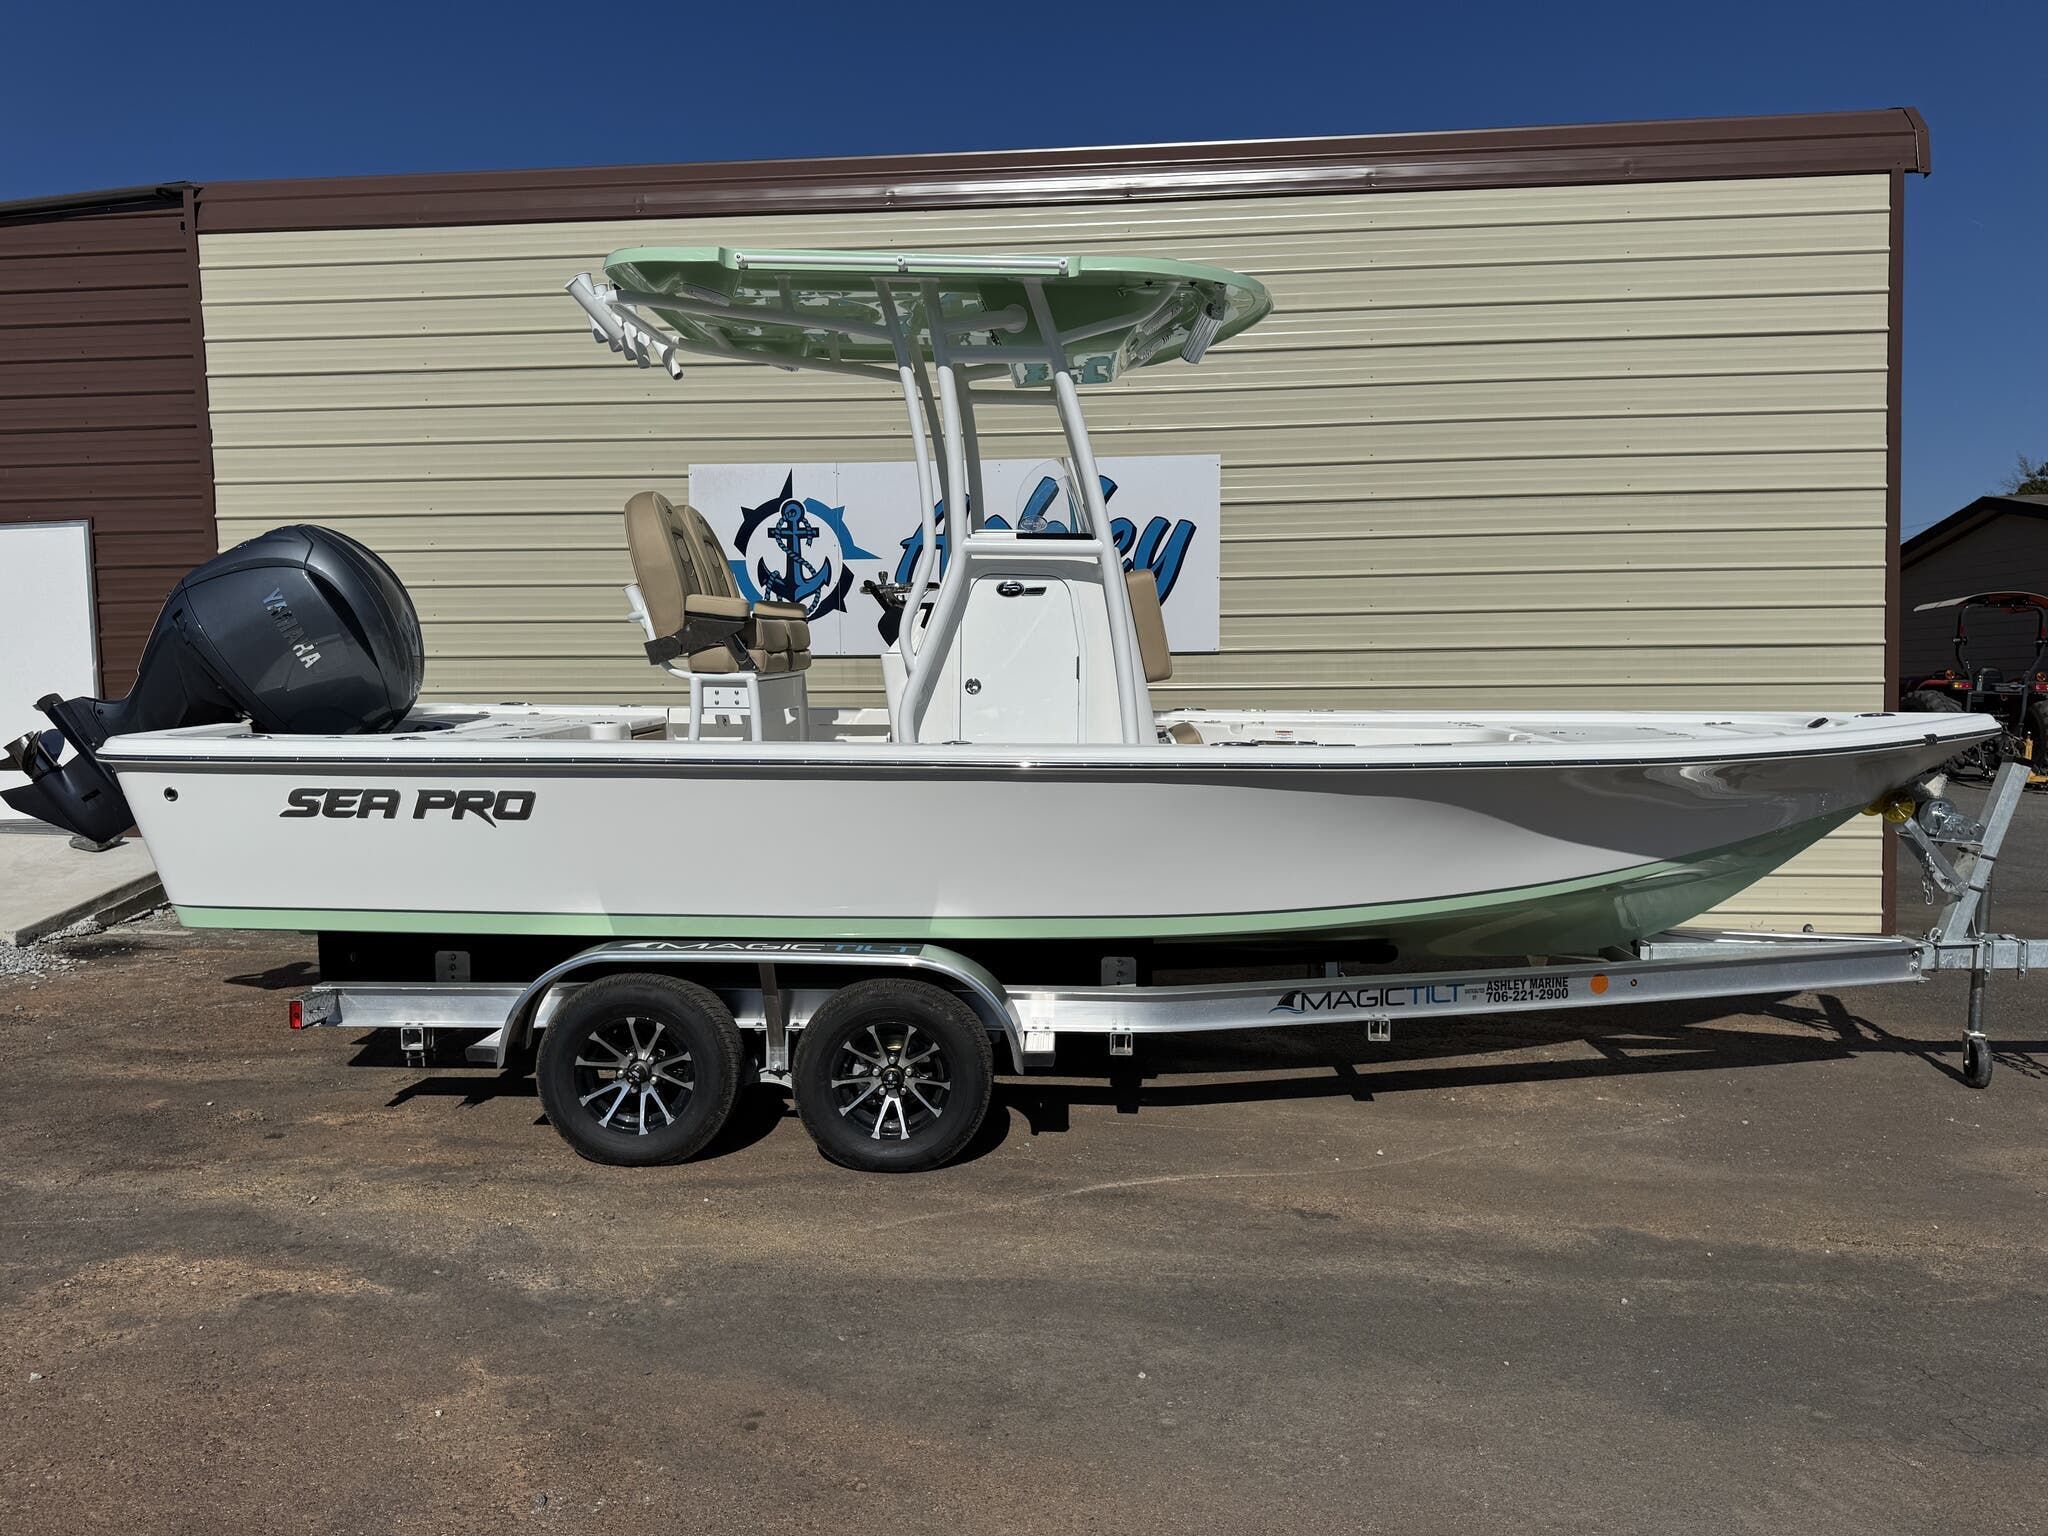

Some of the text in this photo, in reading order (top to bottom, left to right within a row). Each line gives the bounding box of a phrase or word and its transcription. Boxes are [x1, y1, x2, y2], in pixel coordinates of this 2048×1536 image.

[262, 587, 321, 669] YAMAHA
[279, 787, 536, 828] SEA PRO
[1485, 987, 1569, 1003] 706-221-2900
[1486, 976, 1569, 992] ASHLEY MARINE
